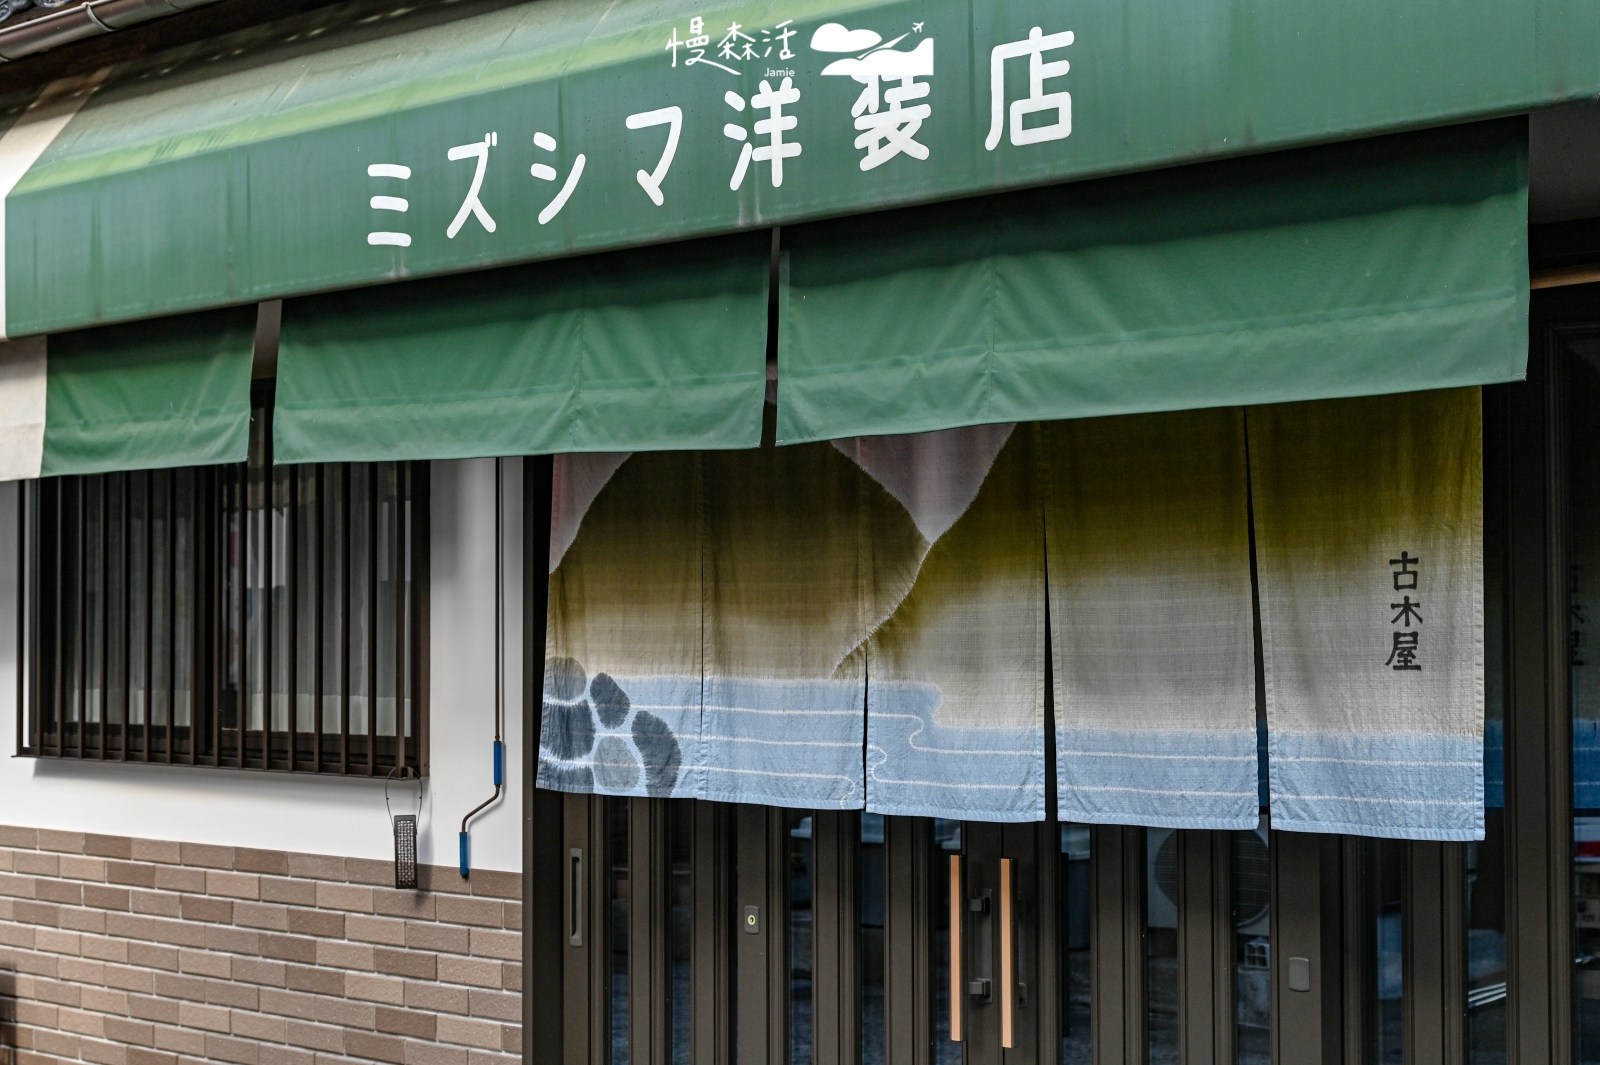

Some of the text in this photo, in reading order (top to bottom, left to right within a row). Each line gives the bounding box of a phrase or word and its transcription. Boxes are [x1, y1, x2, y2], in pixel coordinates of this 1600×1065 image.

[366, 25, 1076, 248] ミズシマ洋装店
[1384, 550, 1424, 672] 古木屋
